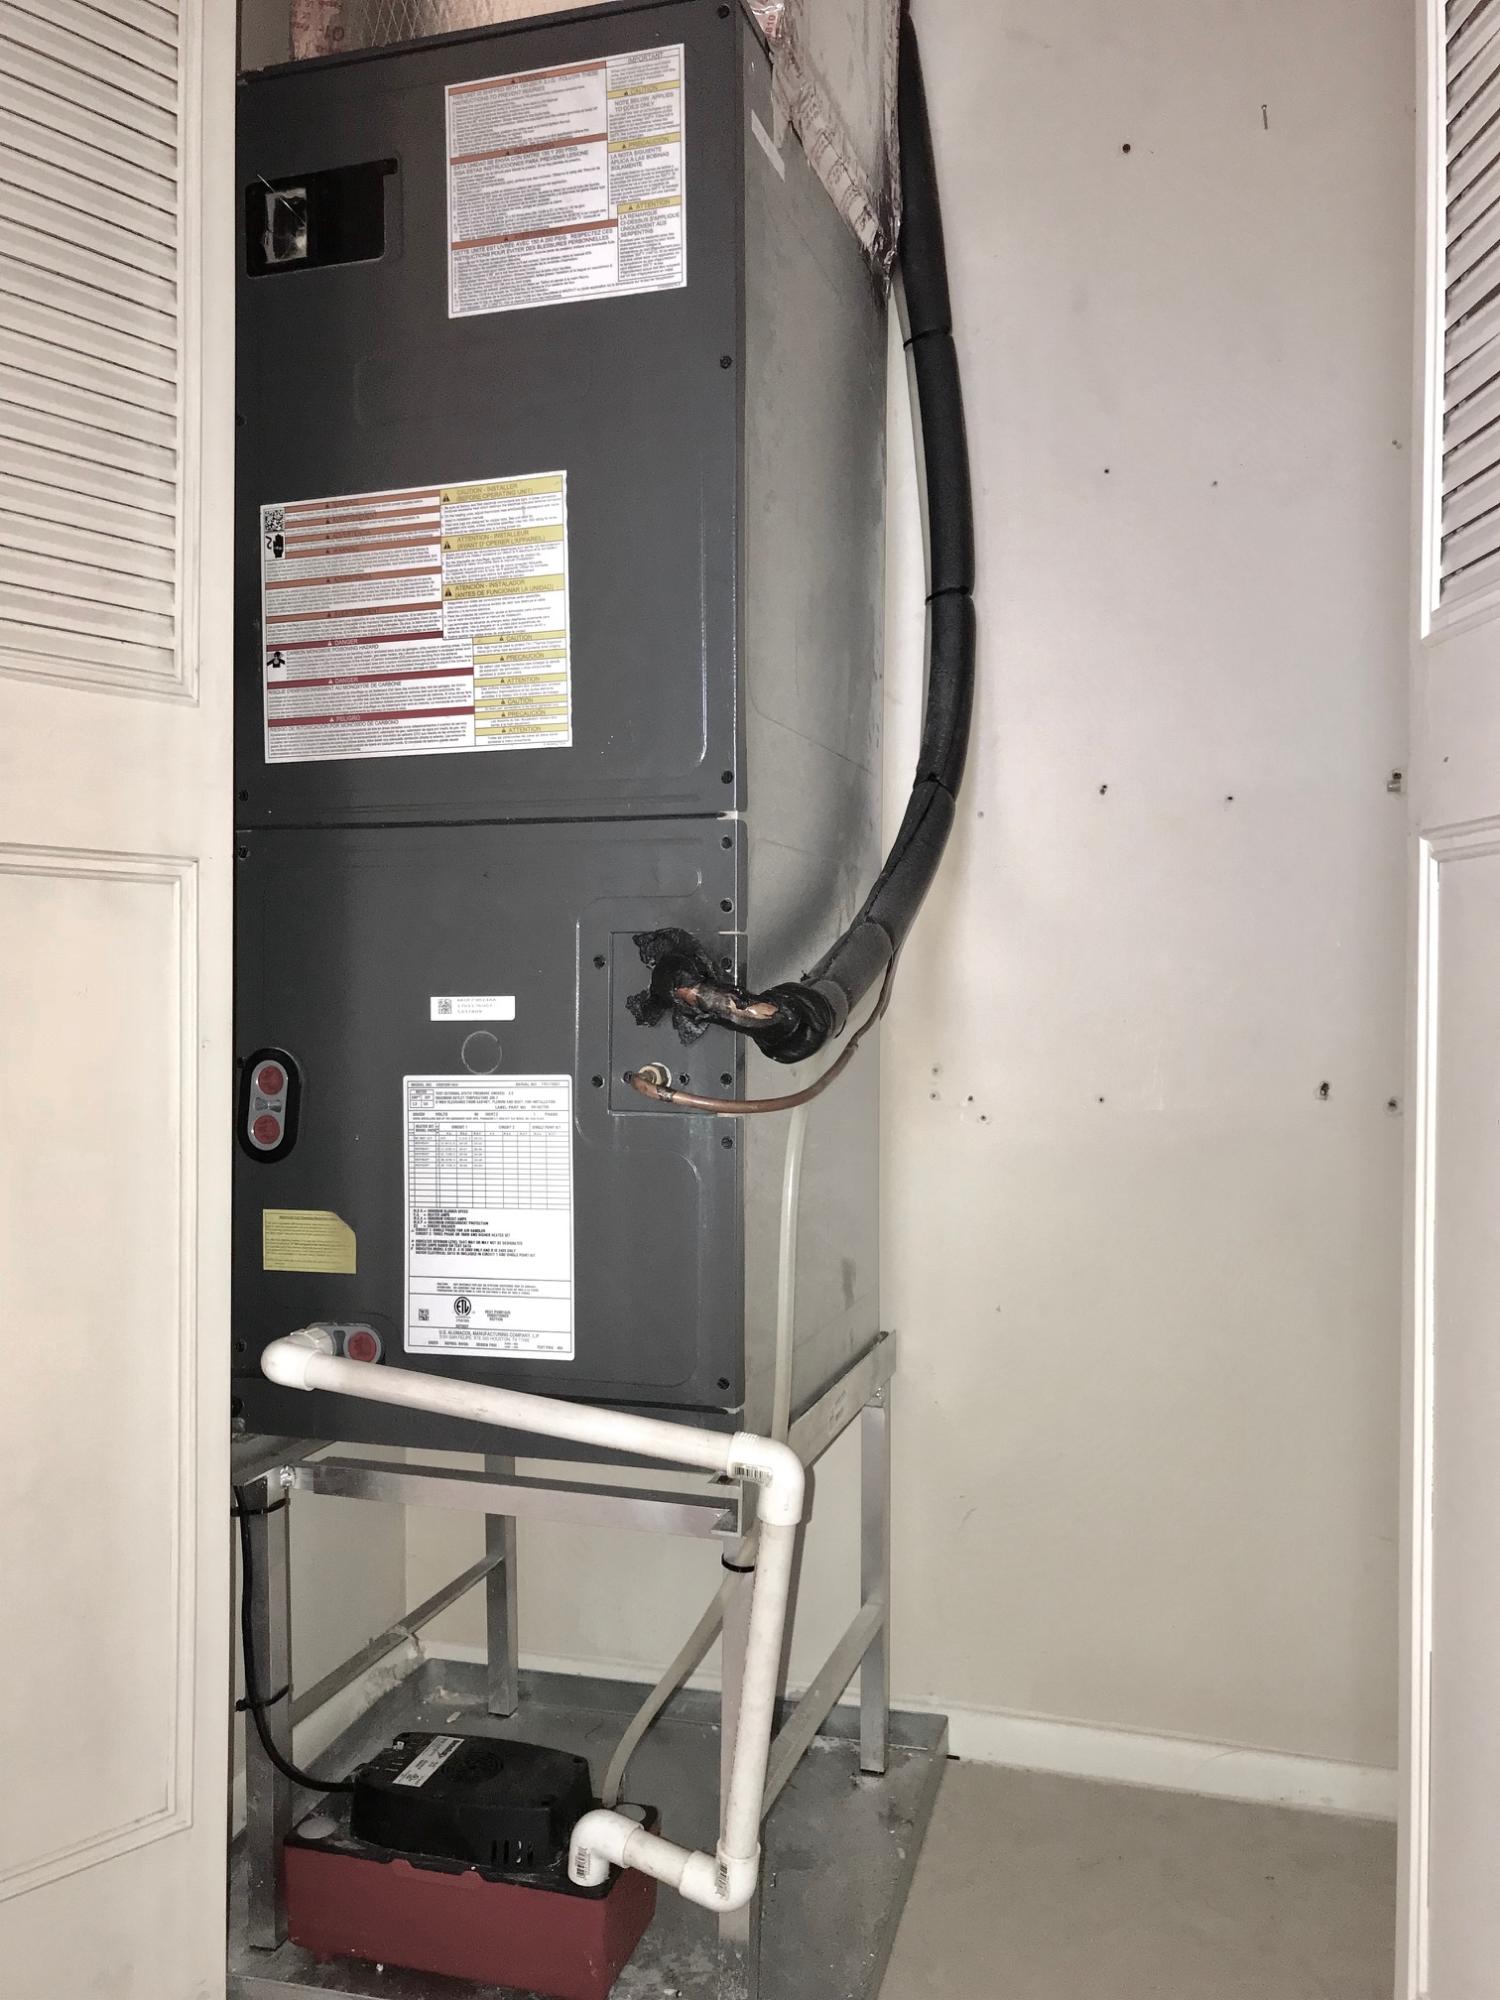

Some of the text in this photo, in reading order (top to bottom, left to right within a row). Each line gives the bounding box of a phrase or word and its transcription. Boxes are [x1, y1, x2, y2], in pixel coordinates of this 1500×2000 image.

[628, 50, 662, 64] IMPORTANT
[452, 95, 488, 106] INSTRUCTIONS
[498, 89, 522, 98] PREVENT
[630, 95, 649, 103] BELOW
[652, 91, 673, 99] APPLIES
[634, 146, 661, 155] SIGUIENTE
[646, 151, 669, 159] BOBINAS
[540, 153, 565, 162] PREVENIR
[611, 161, 641, 171] SOLAMENTE
[636, 198, 670, 209] ATTENTION
[627, 210, 656, 218] REMARQUE
[620, 221, 654, 231] UNIQUEMENT
[570, 230, 600, 239] RESPECTEZ
[620, 228, 653, 237] SERPENTINS
[455, 251, 490, 260] INSTRUCTIONS
[537, 240, 566, 249] BLESSURES
[457, 487, 481, 495] CAUTION
[486, 483, 517, 492] INSTALLER
[481, 489, 516, 499] OPERATING
[457, 534, 487, 542] ATTENTION
[493, 530, 528, 538] INSTALLEUR
[488, 579, 525, 587] INSTALADOR
[486, 586, 520, 595] FUNCIONAR
[505, 633, 532, 642] CAUTION
[506, 675, 540, 683] ATTENTION
